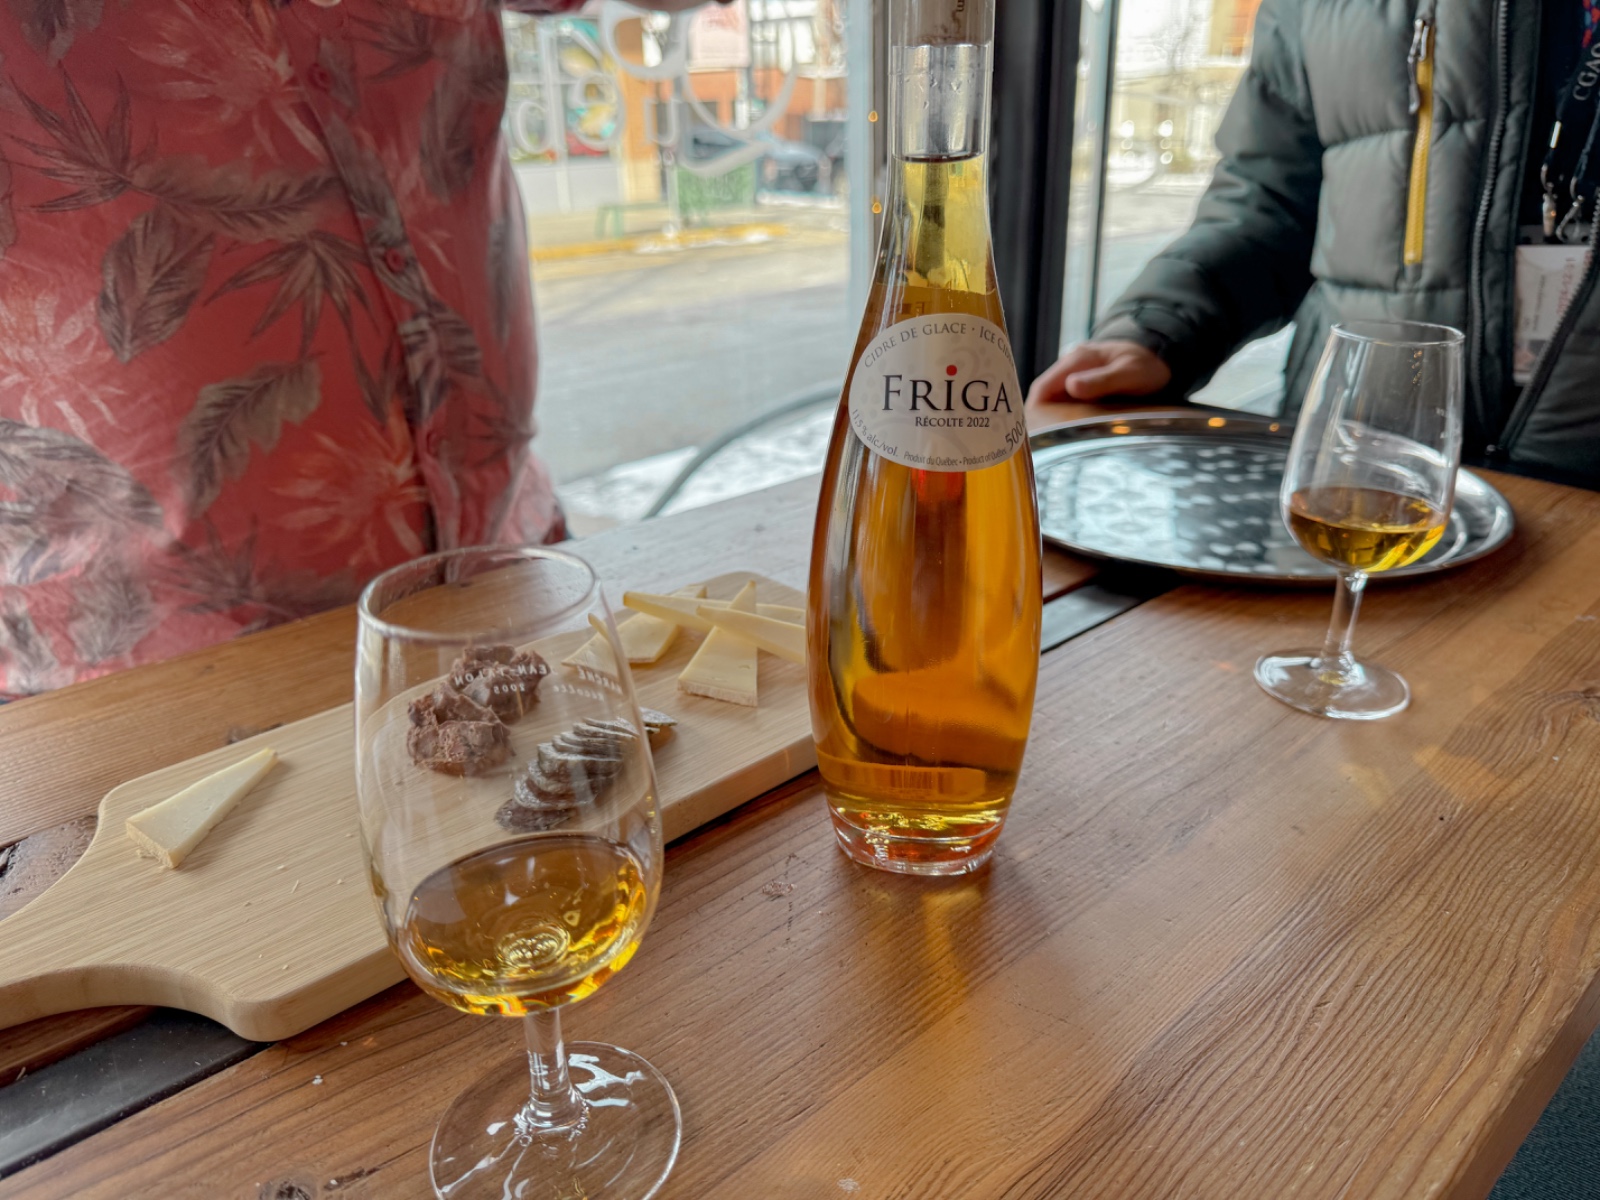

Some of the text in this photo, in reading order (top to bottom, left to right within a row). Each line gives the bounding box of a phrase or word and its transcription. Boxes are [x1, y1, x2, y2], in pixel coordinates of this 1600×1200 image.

[864, 335, 897, 368] CIDRE
[900, 326, 918, 343] DE
[922, 322, 967, 336] GLACE
[979, 325, 996, 344] ICE
[881, 364, 1013, 413] FRIGA
[914, 415, 991, 428] RÉCOLTE 2022
[866, 434, 899, 458] alc./vol.
[1004, 420, 1024, 452] 500
[903, 450, 926, 464] Produit
[926, 455, 935, 466] du
[963, 455, 985, 466] Product
[985, 452, 991, 462] of
